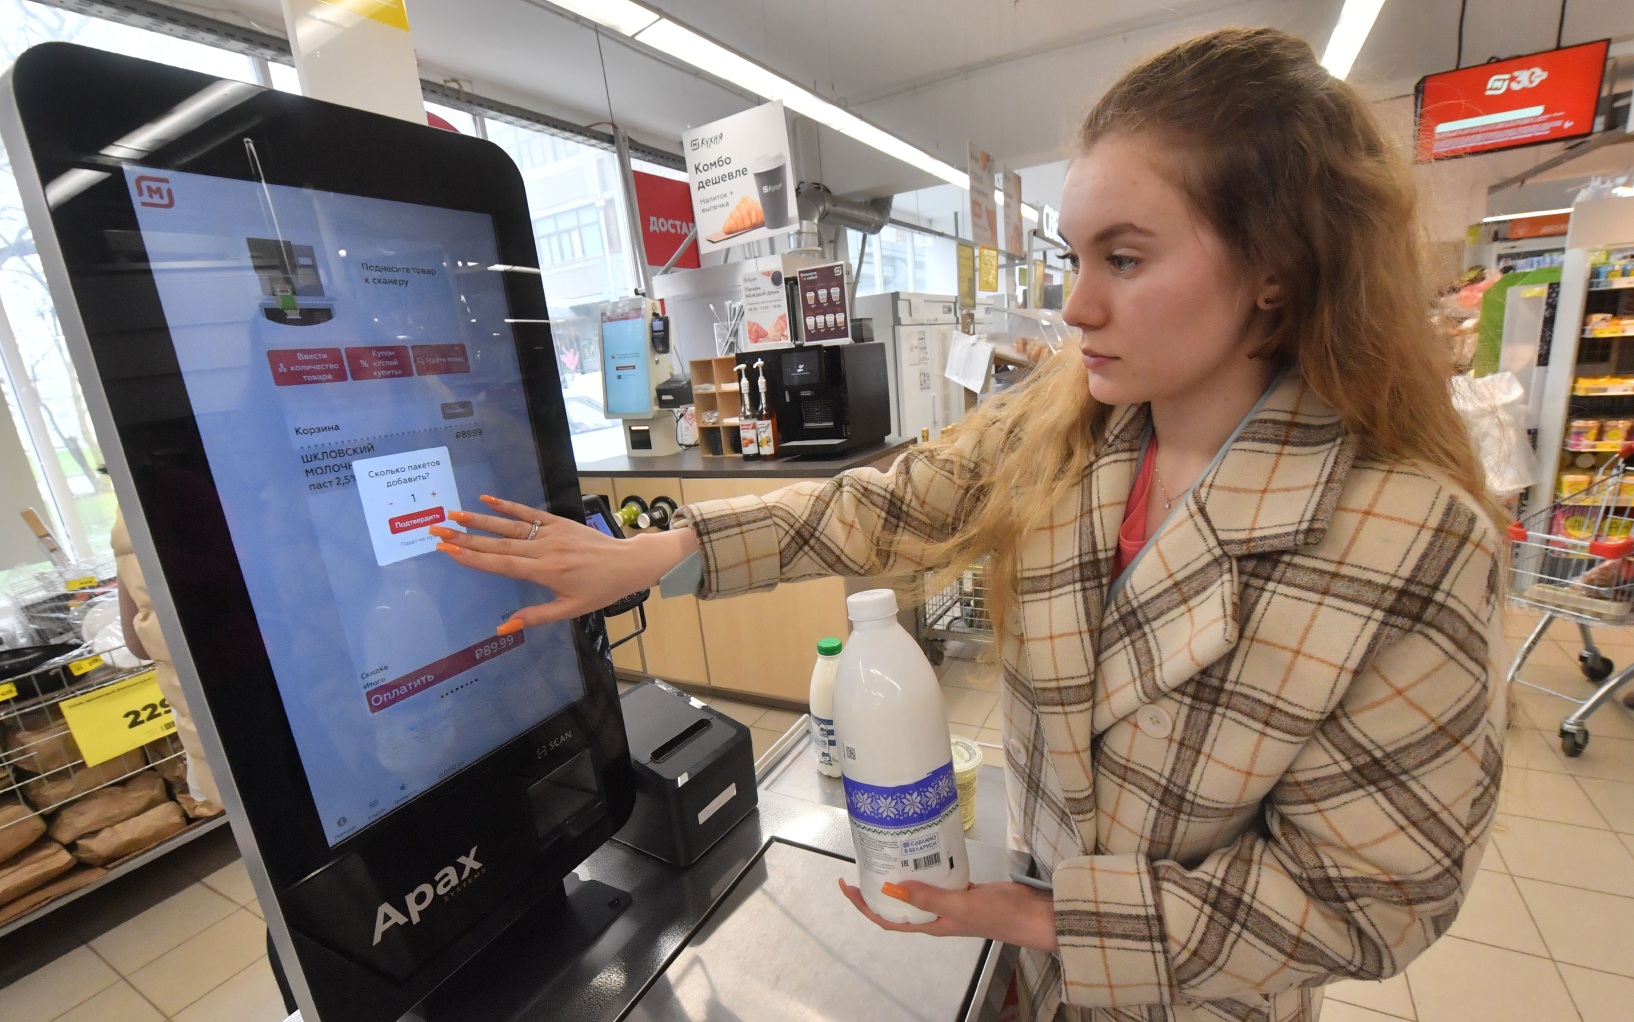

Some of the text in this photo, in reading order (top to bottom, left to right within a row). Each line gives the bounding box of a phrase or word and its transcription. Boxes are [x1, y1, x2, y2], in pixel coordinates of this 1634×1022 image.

[694, 154, 732, 175] Комбо
[697, 166, 748, 191] дешевле
[700, 192, 728, 205] Напиток
[701, 201, 730, 214] выпечка
[361, 262, 437, 277] Поднесите товар
[372, 277, 409, 288] сканеру
[297, 352, 328, 361] Ввести
[371, 349, 395, 360] Купон
[290, 362, 339, 372] количество
[302, 372, 333, 382] товара
[294, 423, 340, 437] Корзина
[301, 442, 376, 465] ШКЛОВСКИЙ
[368, 459, 441, 479] Сколько пакетов
[308, 479, 334, 492] паст
[386, 472, 430, 488] добавить?
[410, 493, 417, 503] 1
[394, 512, 440, 530] Подтвердить
[400, 538, 417, 548] Пакет
[360, 664, 389, 681] Скидка
[363, 676, 386, 691] Итого
[371, 672, 436, 707] Оплатить
[548, 730, 573, 751] SCAN
[909, 841, 938, 853] БЕЛАРУСИ
[910, 835, 937, 847] СДЕЛАНО
[443, 867, 488, 903] SYSTEMS
[372, 845, 484, 947] Apax
